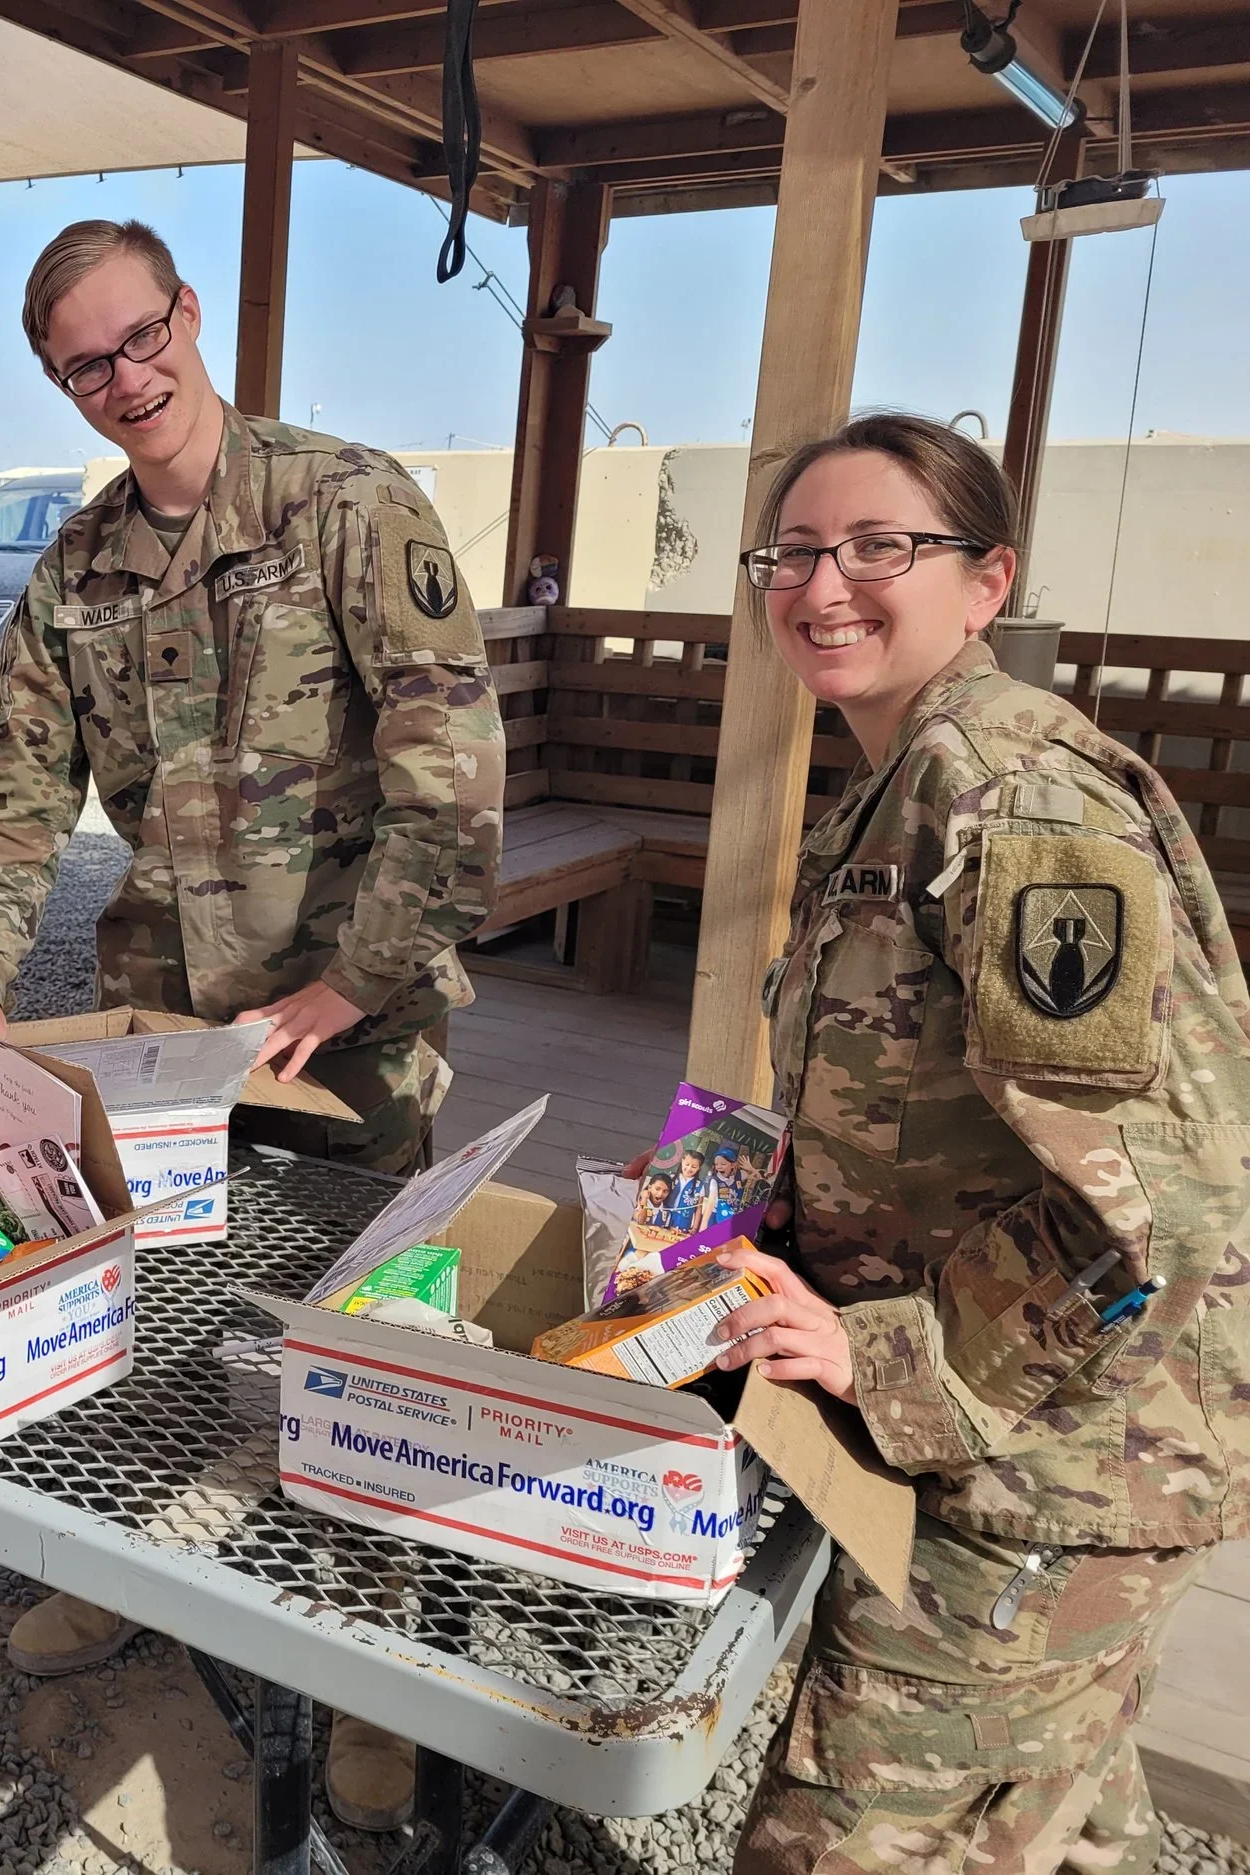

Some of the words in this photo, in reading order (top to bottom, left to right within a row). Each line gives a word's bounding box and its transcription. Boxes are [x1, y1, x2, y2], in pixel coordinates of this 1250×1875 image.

[256, 552, 296, 583] ARMY
[81, 603, 119, 626] WADE
[839, 868, 892, 896] ARM
[21, 1099, 37, 1117] you
[677, 1098, 692, 1107] girl
[691, 1101, 713, 1114] scouts
[134, 1140, 172, 1151] INSURED
[179, 1137, 218, 1148] TRACKED
[151, 1213, 181, 1223] UNITED
[58, 1279, 100, 1305] AMERICA
[58, 1288, 101, 1313] SUPPORTS
[7, 1301, 35, 1320] MAIL
[348, 1391, 394, 1413] POSTAL
[351, 1375, 401, 1395] UNITED
[401, 1387, 448, 1407] STATES
[499, 1425, 544, 1447] MAIL
[301, 1461, 356, 1486] TRACKED
[363, 1480, 417, 1503] INSURED
[331, 1422, 655, 1531] MoveAmericaForward.org
[585, 1457, 658, 1484] AMERICA
[582, 1469, 659, 1498] SUPPORTS
[561, 1526, 591, 1541] VISIT
[593, 1532, 609, 1546] US
[610, 1537, 626, 1550] AT
[560, 1535, 590, 1549] ORDER
[591, 1542, 613, 1555] FREE
[615, 1548, 657, 1566] SUPPLIES
[657, 1558, 692, 1571] ONLINE
